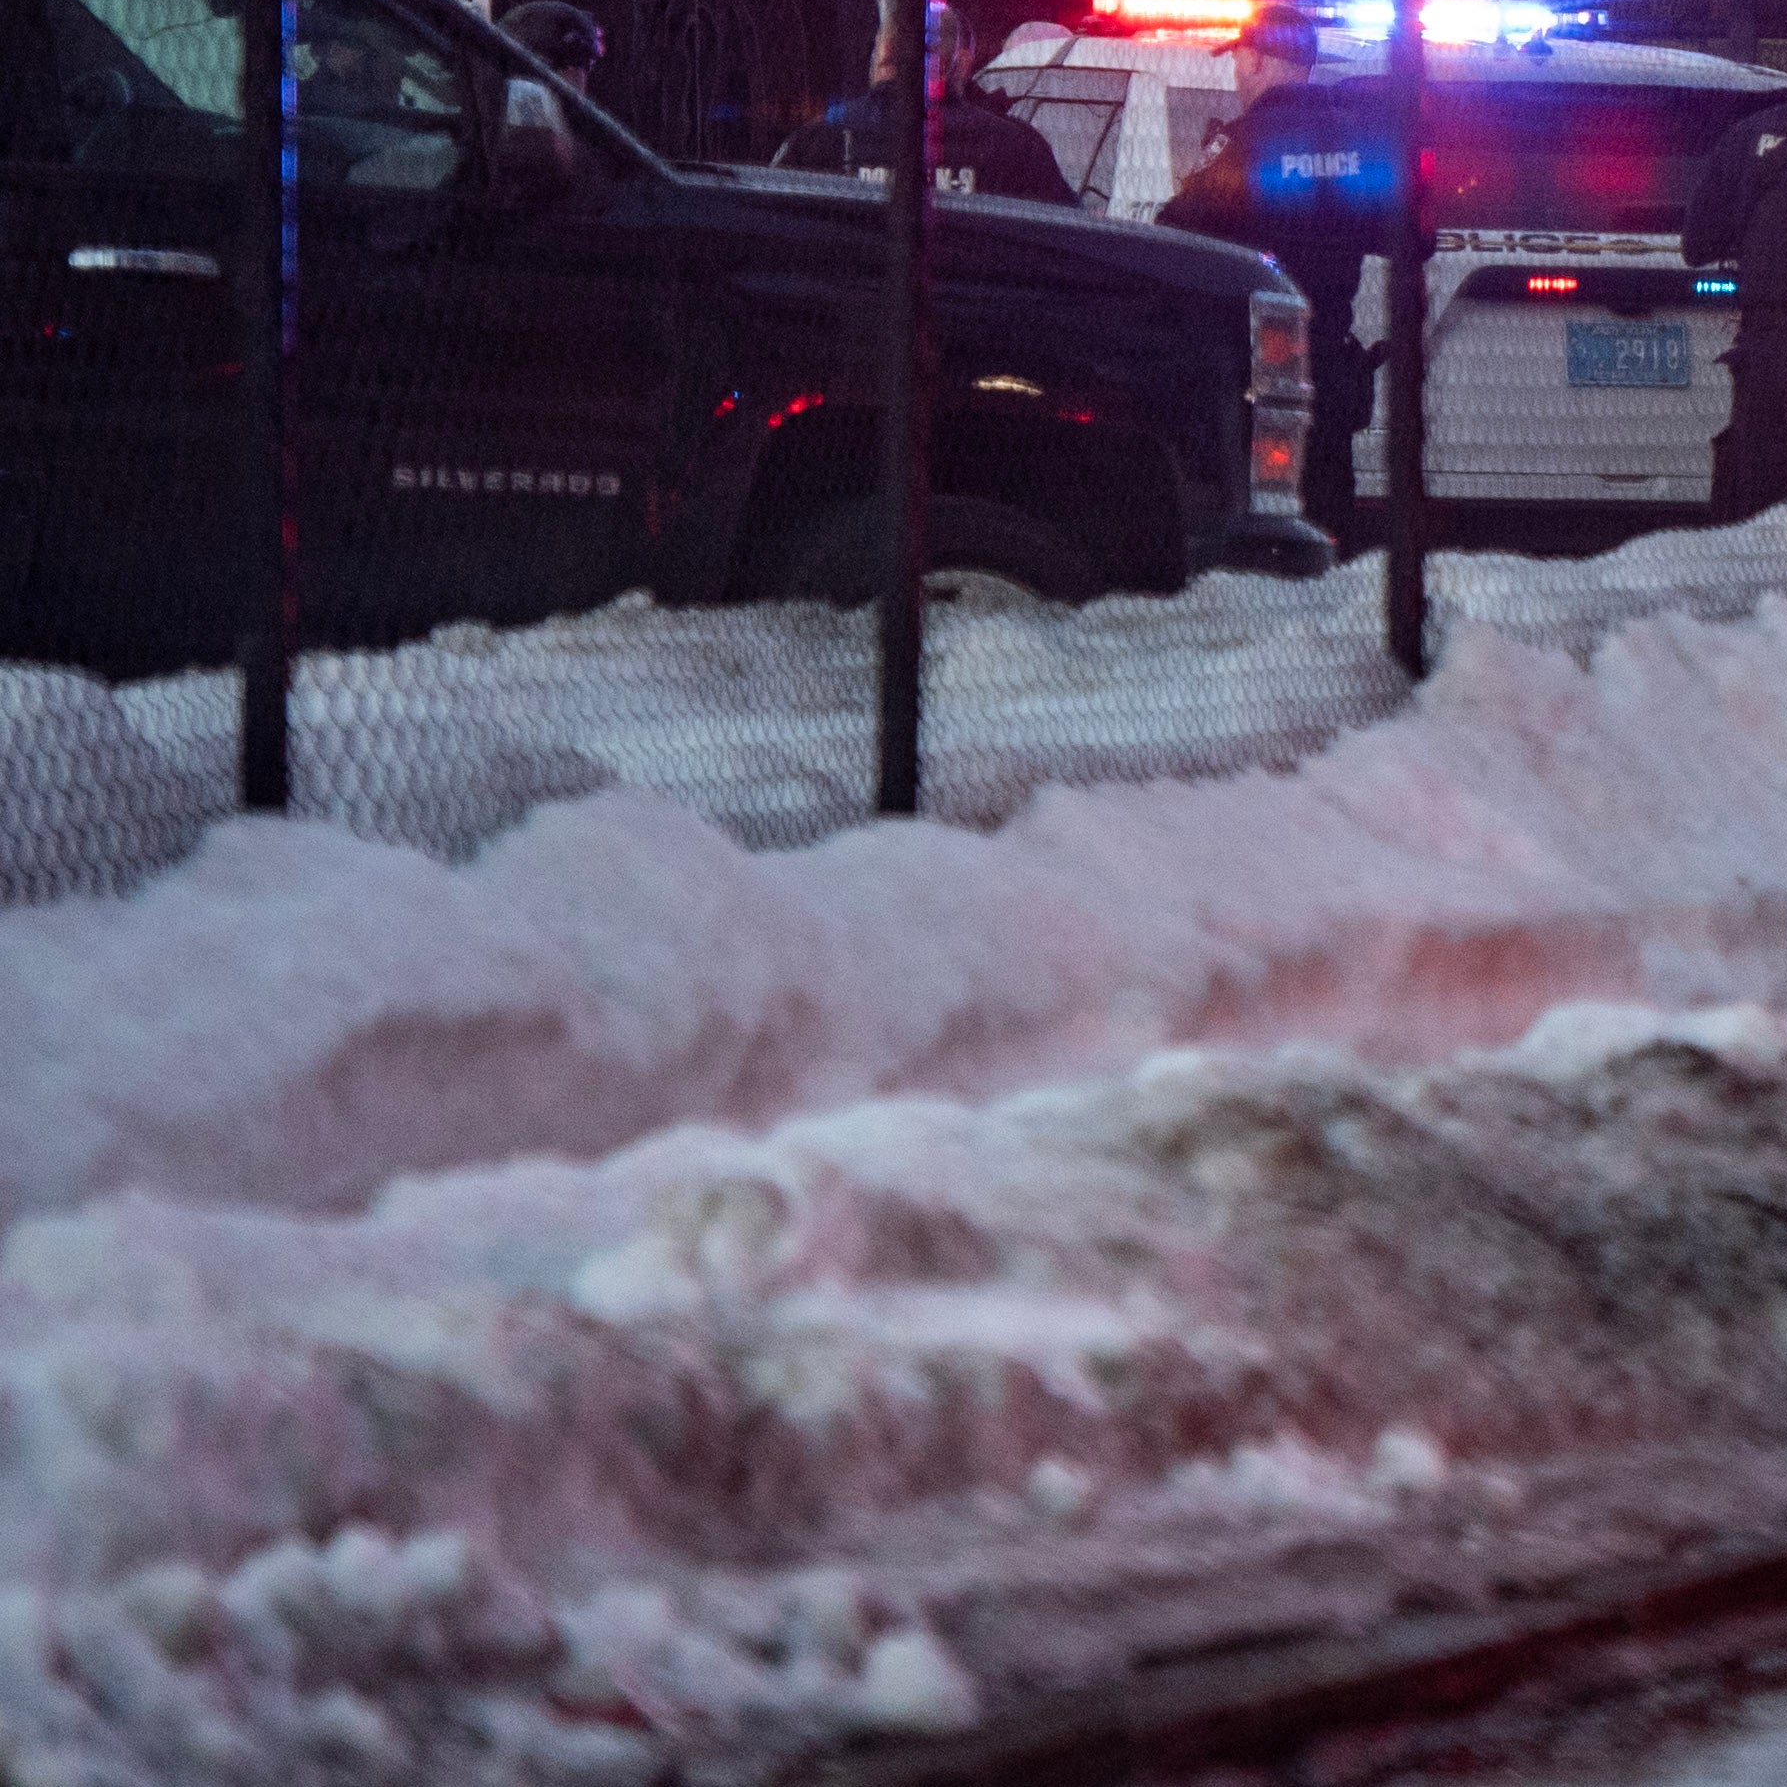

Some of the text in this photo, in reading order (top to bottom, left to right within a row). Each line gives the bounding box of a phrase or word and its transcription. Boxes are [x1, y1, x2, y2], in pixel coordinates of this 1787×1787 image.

[1280, 152, 1361, 179] POLICE
[1435, 231, 1602, 255] OLICE
[392, 466, 622, 497] SILVERADO
